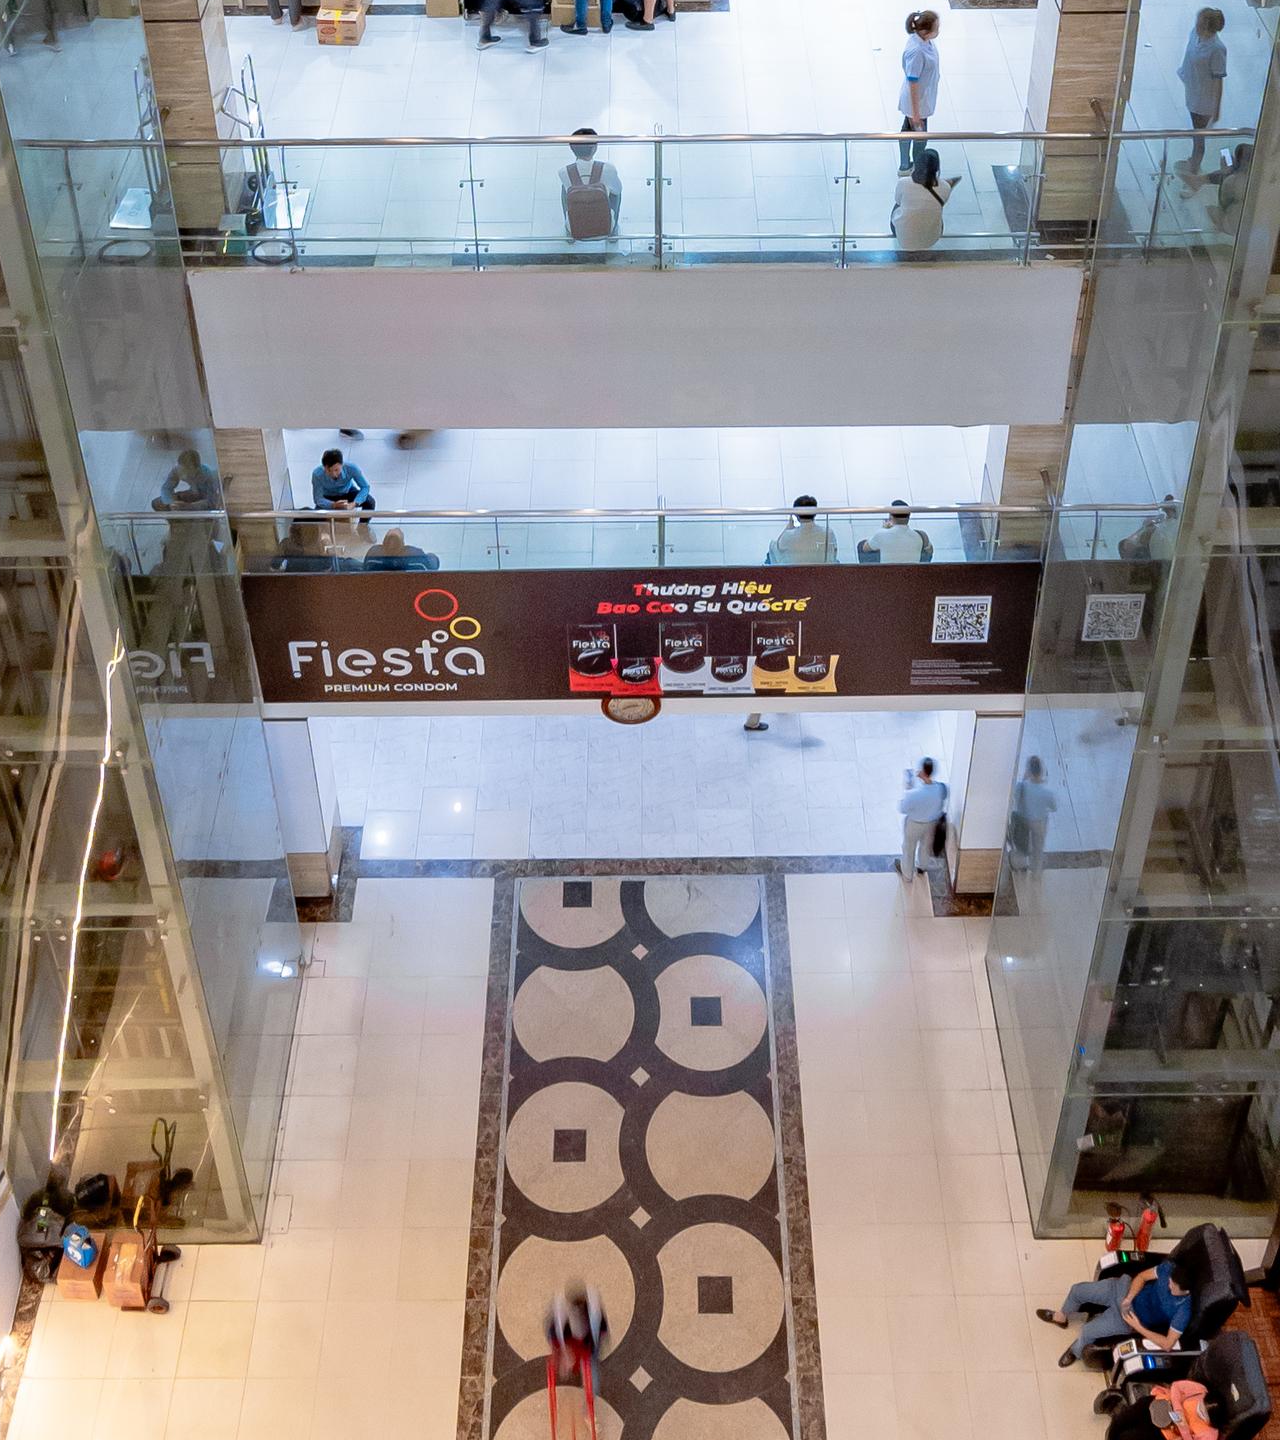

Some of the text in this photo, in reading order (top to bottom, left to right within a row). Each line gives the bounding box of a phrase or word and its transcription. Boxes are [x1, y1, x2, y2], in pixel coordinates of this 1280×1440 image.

[633, 581, 772, 598] Thương Hiệu
[597, 602, 640, 614] Bao
[646, 601, 688, 613] Cao
[693, 600, 721, 613] Su
[572, 639, 610, 649] Fiesta
[664, 638, 703, 648] Fiesta
[756, 636, 794, 646] Fiesta
[288, 639, 486, 679] Fiesta
[324, 682, 458, 693] PREMIUM CONDOM
